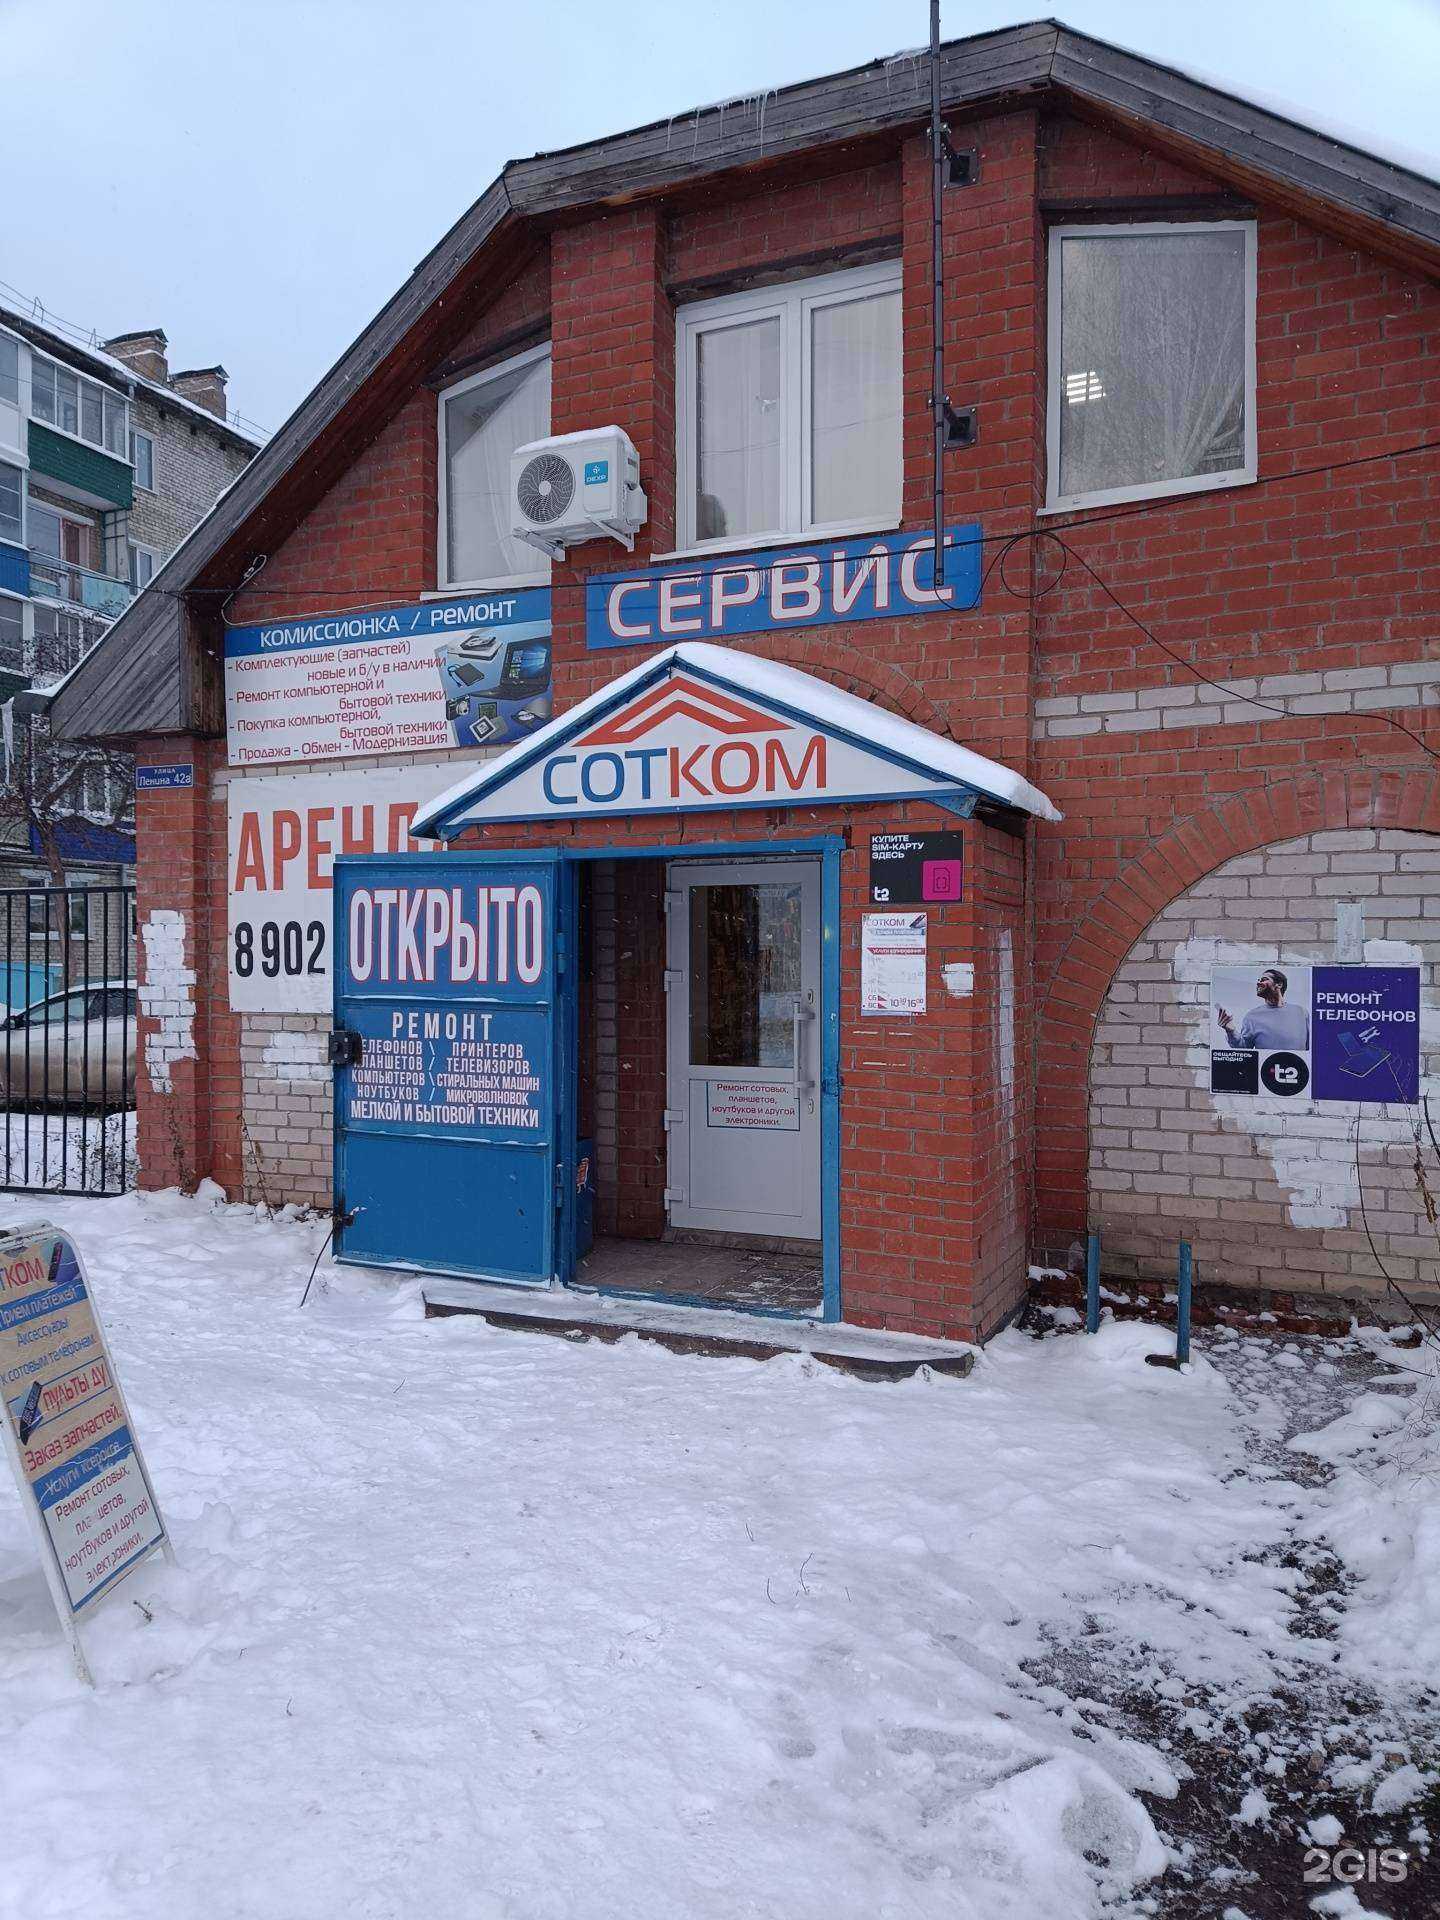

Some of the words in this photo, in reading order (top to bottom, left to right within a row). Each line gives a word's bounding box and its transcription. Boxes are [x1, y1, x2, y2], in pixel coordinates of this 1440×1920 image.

[608, 535, 954, 638] СЕРВИС
[260, 615, 400, 647] КОМИССИОНКА
[235, 653, 335, 671] Комплектующие
[338, 640, 411, 662] (запчастей)
[307, 669, 346, 681] новые
[349, 667, 356, 677] и
[359, 662, 380, 677] б/у
[383, 664, 390, 673] в
[393, 657, 446, 672] наличии
[236, 690, 281, 703] Ремонт
[283, 679, 373, 698] компьютерной
[376, 679, 385, 689] и
[339, 693, 393, 710] бытовой
[395, 691, 447, 703] техники
[237, 718, 286, 732] Покупка
[288, 708, 381, 727] компьютерной,
[340, 722, 393, 739] бытовой
[396, 720, 447, 733] техники
[238, 747, 291, 761] Продажа
[301, 742, 342, 755] Обмен
[352, 733, 448, 751] Модернизация
[542, 735, 827, 804] СОТКОМ
[139, 776, 170, 786] Ленина
[234, 802, 441, 891] АРЕН
[872, 835, 909, 843] КУПИТЕ
[872, 842, 924, 851] SIM-КАРТУ
[872, 851, 905, 860] ЗДЕСЬ
[350, 886, 542, 983] ОТКРЫТО
[234, 920, 326, 978] 8902
[1316, 992, 1383, 1005] РЕМОНТ
[1316, 1009, 1416, 1022] ТЕЛЕФОНОВ
[392, 1012, 493, 1041] РЕМОНТ
[361, 1039, 422, 1055] ЕЛЕФОНОВ
[452, 1042, 523, 1059] ПРИНТЕРОВ
[354, 1055, 423, 1071] ЛАНШЕТОВ
[446, 1058, 530, 1075] ТЕЛЕВИЗОРОВ
[351, 1070, 425, 1086] КОМПЬЮТЕРОВ
[436, 1073, 500, 1089] СТИРАЛЬНЫХ
[502, 1076, 540, 1091] МАШИН
[357, 1085, 419, 1100] НОУТБУКОВ
[446, 1089, 529, 1106] МИКРОВОЛНОВОК
[716, 1083, 748, 1092] Ремонт
[750, 1085, 789, 1094] сотовых,
[728, 1096, 777, 1105] планшетов,
[351, 1100, 401, 1120] МЕЛКОЙ
[404, 1103, 413, 1121] И
[415, 1103, 475, 1124] БЫТОВОЙ
[478, 1107, 539, 1128] ТЕХНИКИ
[711, 1105, 756, 1115] ноутбуков
[765, 1107, 795, 1117] другой
[43, 1373, 90, 1411] ПУЛЬТЫ
[91, 1364, 106, 1387] ДУ
[25, 1439, 63, 1472] Заказ
[55, 1489, 91, 1522] Ремонт
[65, 1528, 112, 1572] ноутбуков
[112, 1523, 118, 1536] и
[120, 1498, 150, 1531] другой
